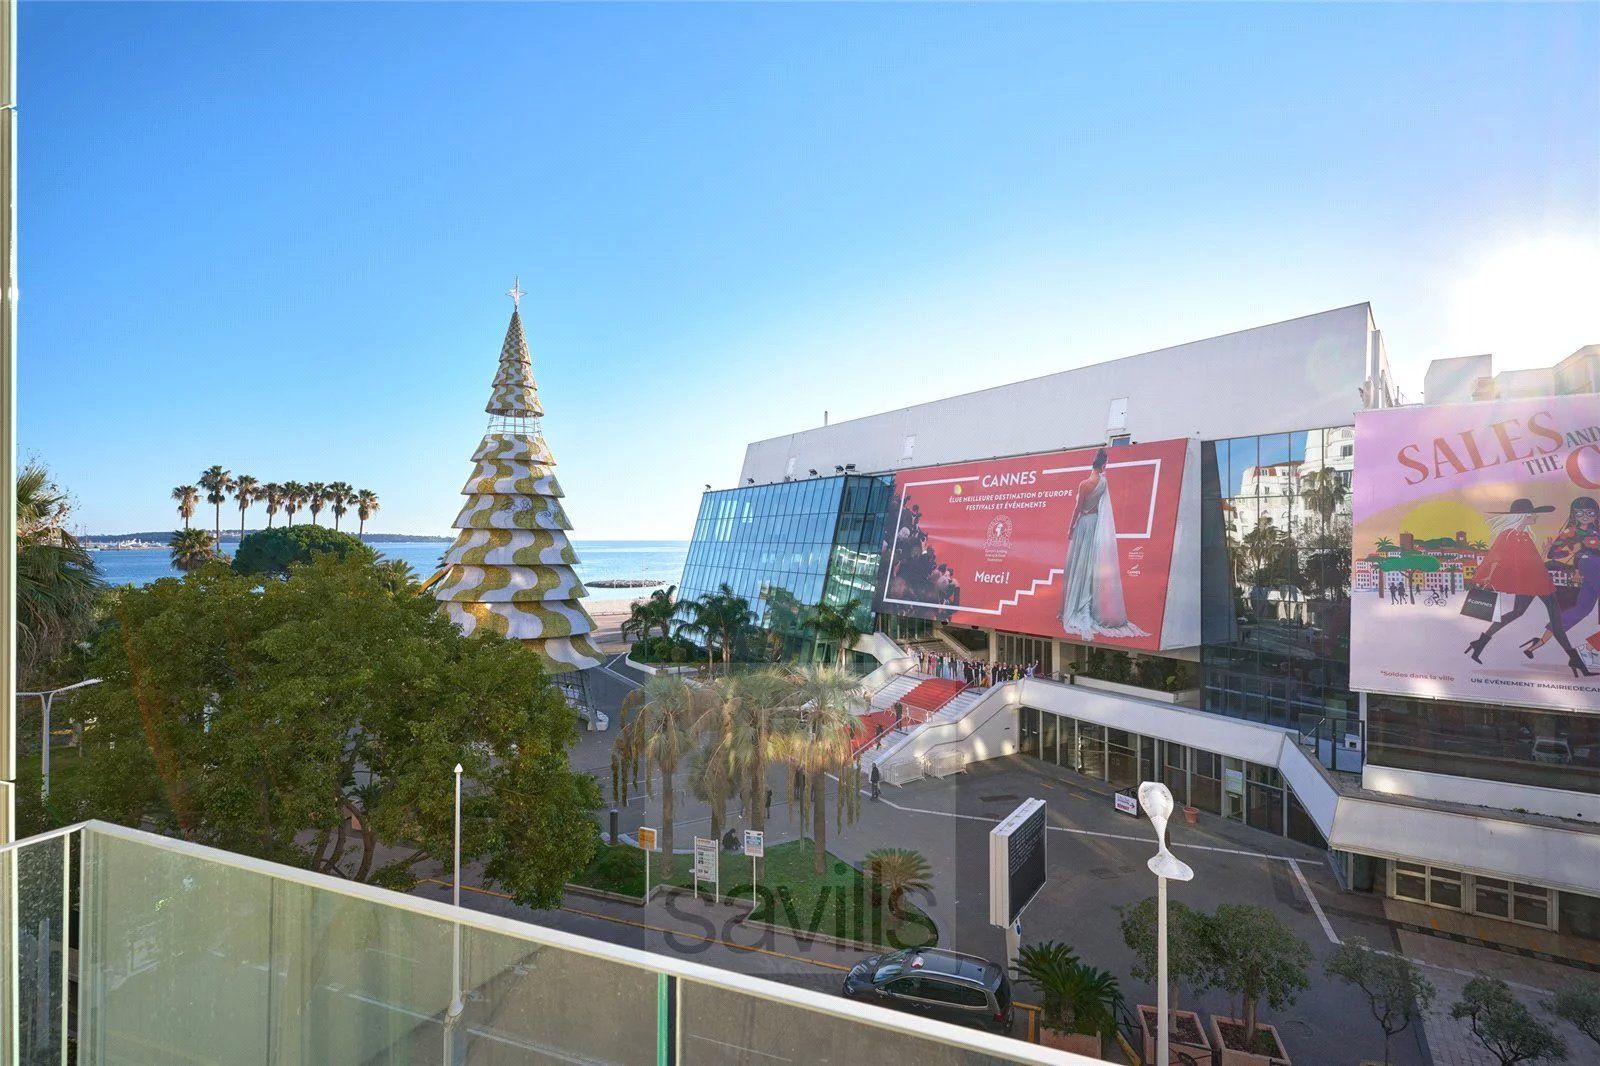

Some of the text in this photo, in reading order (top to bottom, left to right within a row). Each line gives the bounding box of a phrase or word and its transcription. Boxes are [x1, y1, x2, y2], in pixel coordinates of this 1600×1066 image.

[1397, 411, 1564, 485] SALES
[1522, 454, 1564, 476] THE
[982, 471, 1037, 487] CANNES
[949, 489, 1073, 503] ÉLUE MEILLEURE DESTINATION D'EUROPE
[1004, 501, 1047, 510] ÉVÉNEMENTS
[1409, 672, 1428, 680] dans
[1484, 677, 1536, 688] ÉVÉNEMENT
